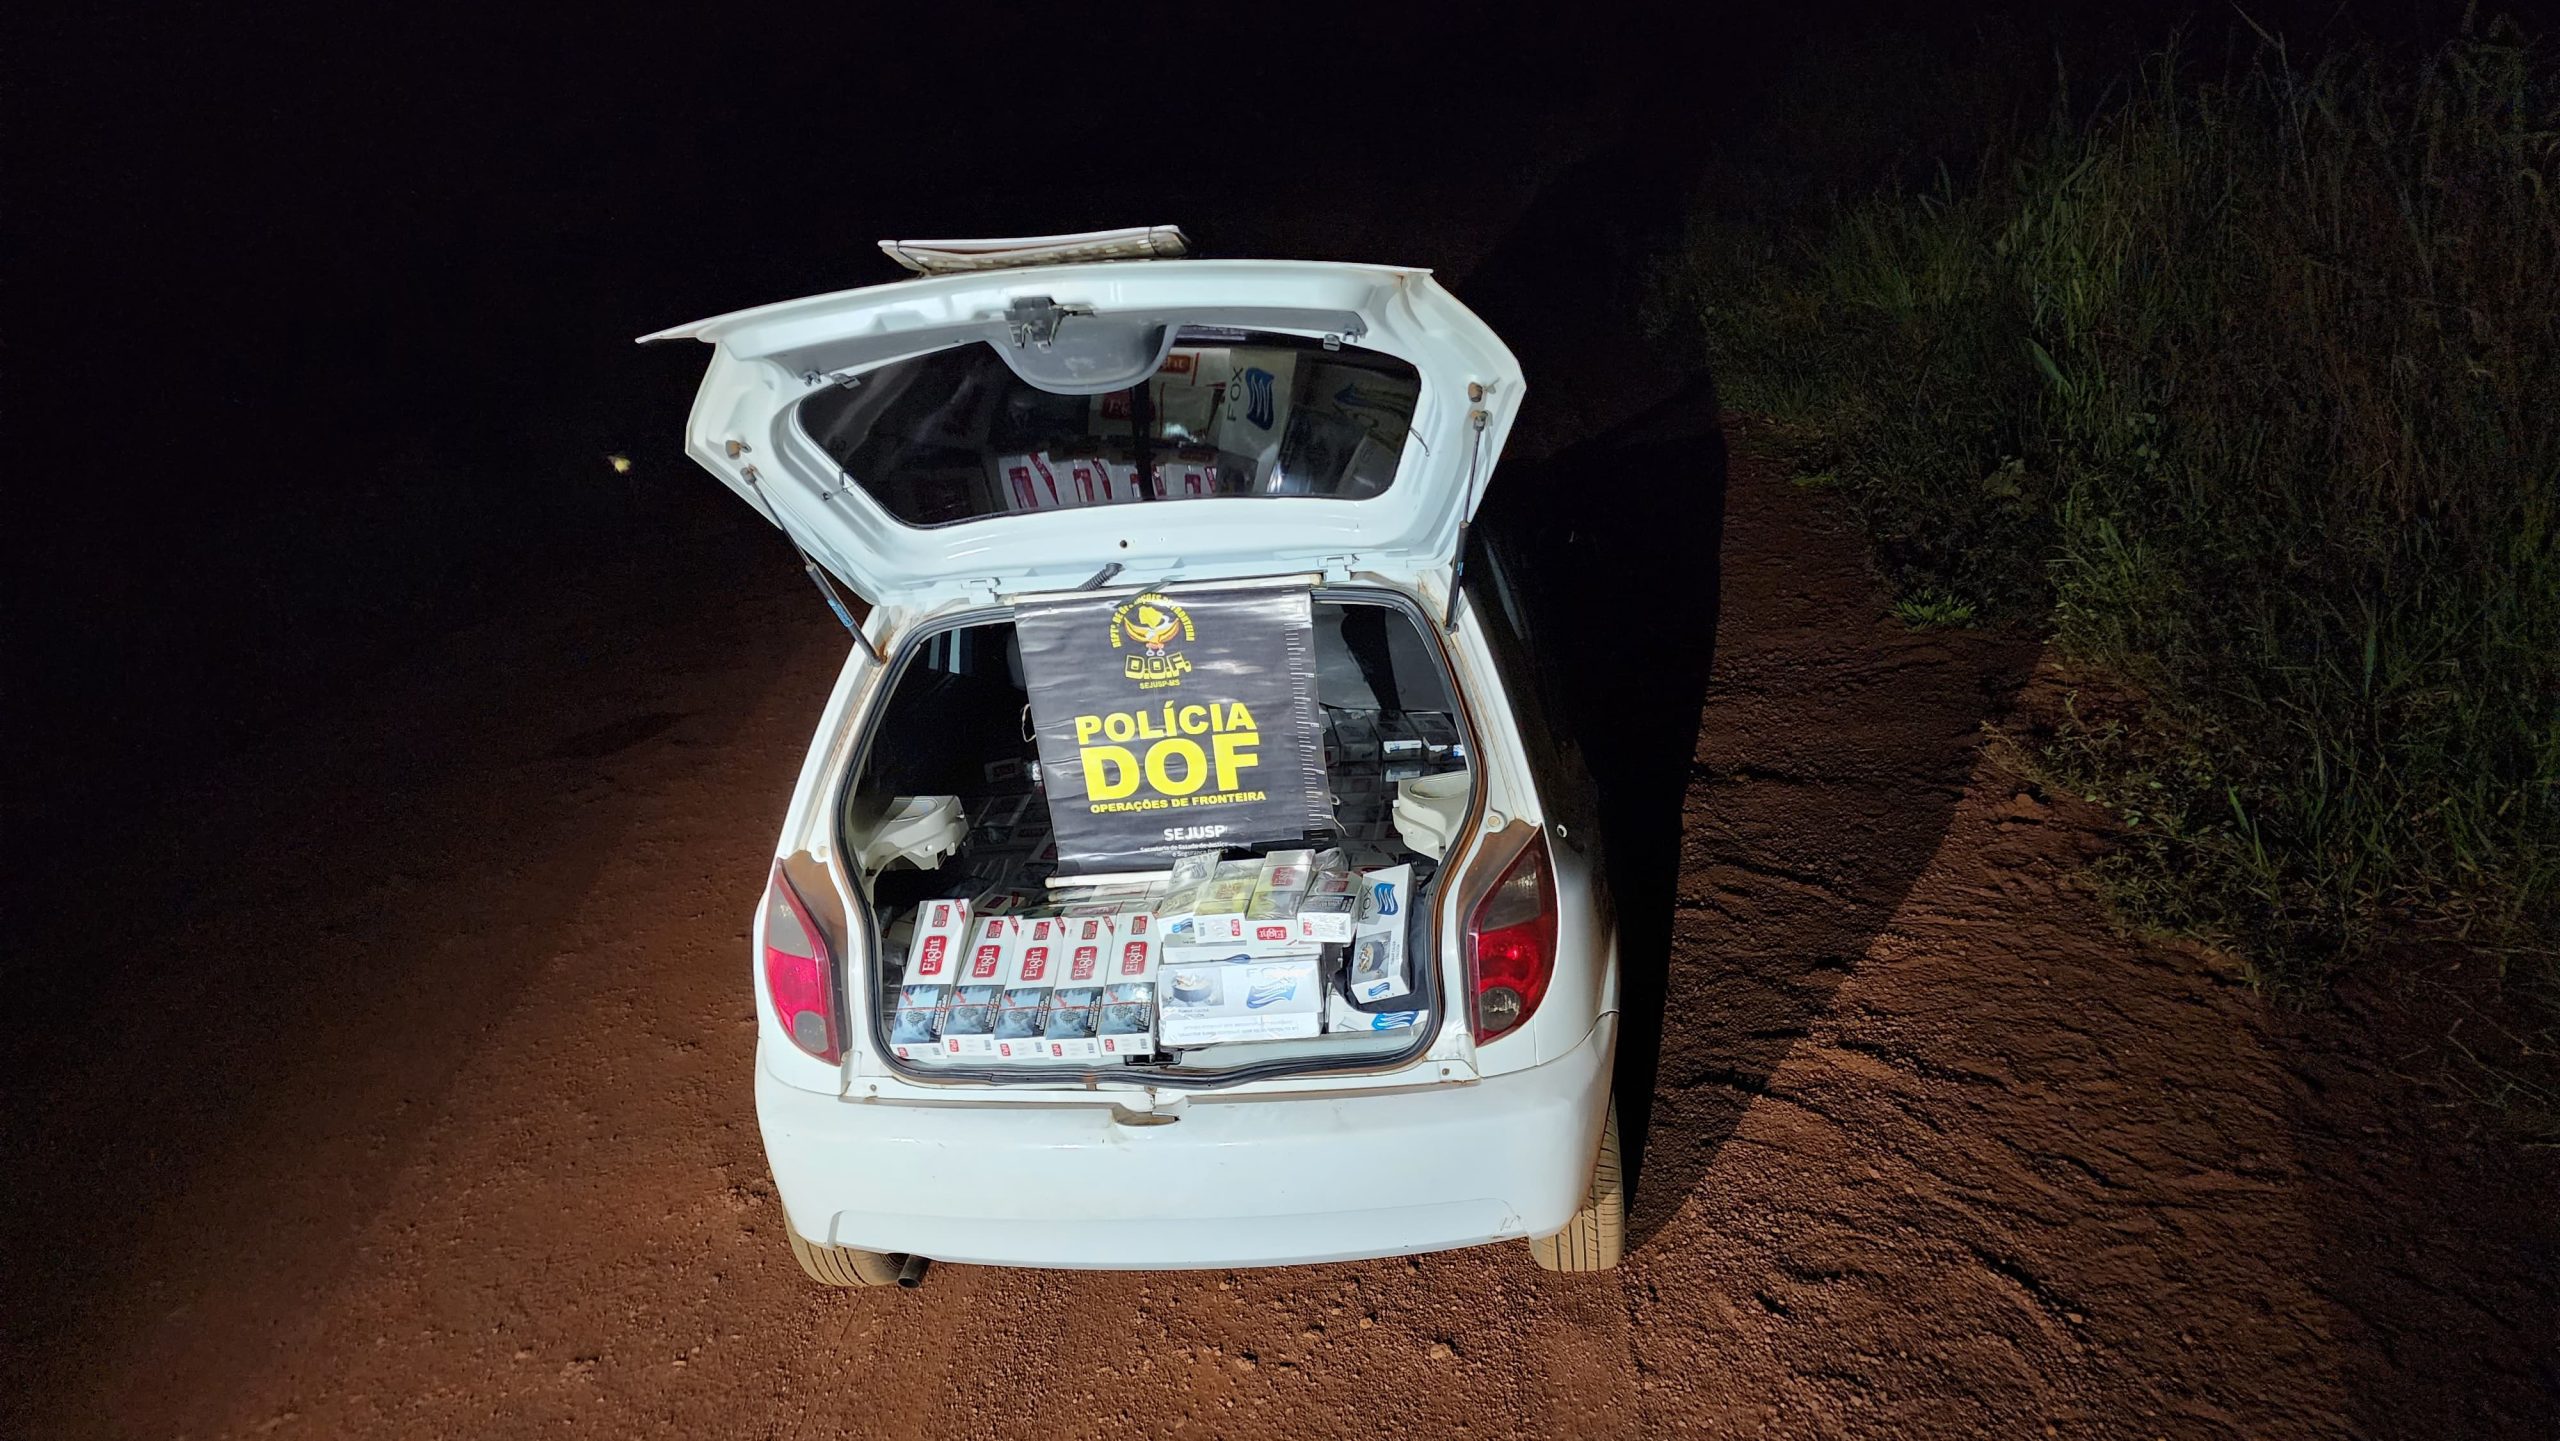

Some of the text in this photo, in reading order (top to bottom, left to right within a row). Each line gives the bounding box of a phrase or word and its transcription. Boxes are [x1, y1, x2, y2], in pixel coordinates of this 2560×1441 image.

[1227, 367, 1243, 421] FOX
[1075, 700, 1257, 745] POLÍCIA
[1080, 733, 1260, 802] DOF
[1090, 791, 1267, 814] OPERAÇÕES DE FRONTEIRA
[1163, 825, 1226, 842] SEJUSP
[1361, 886, 1373, 920] FOX
[922, 938, 942, 972] Eight
[976, 946, 996, 976] Eight
[1023, 948, 1043, 978] Eight
[1074, 947, 1093, 978] Eight
[1124, 944, 1143, 974] Eight
